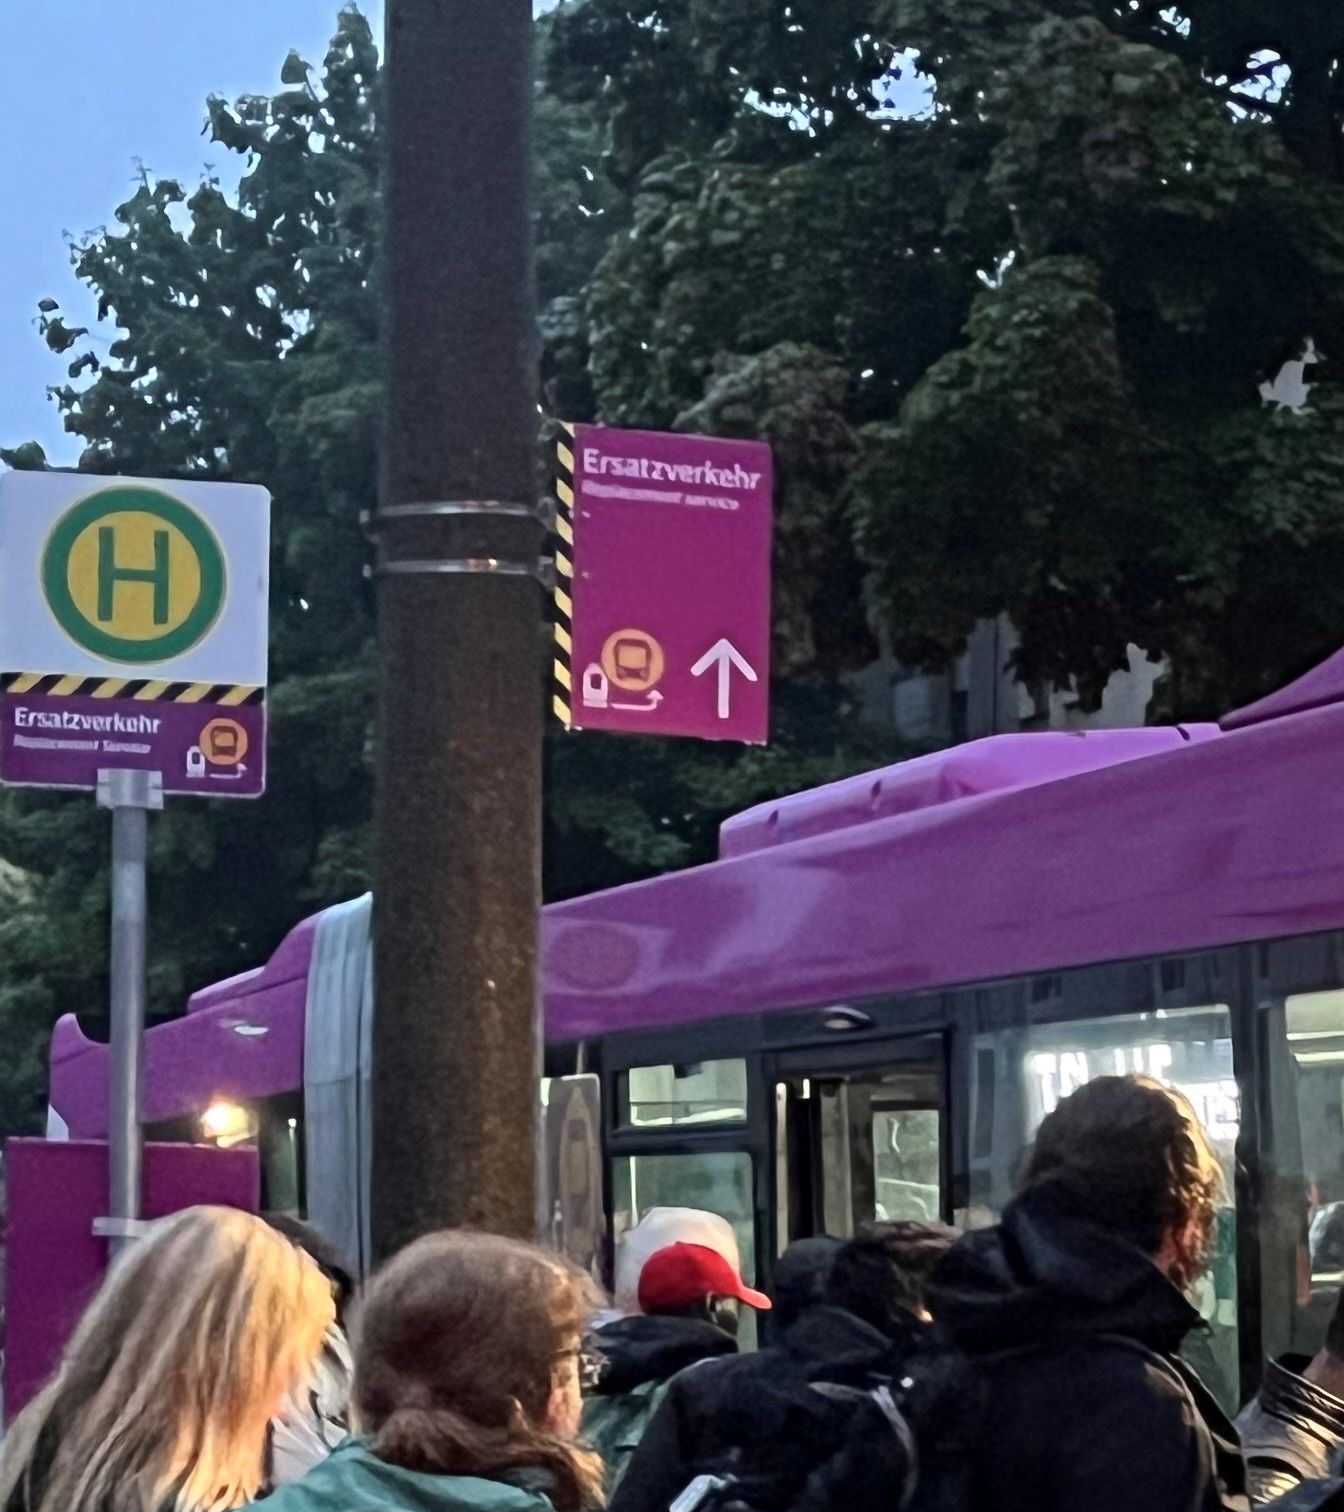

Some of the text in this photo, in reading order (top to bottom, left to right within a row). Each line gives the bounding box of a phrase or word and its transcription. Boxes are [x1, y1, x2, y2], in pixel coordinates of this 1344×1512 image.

[583, 447, 761, 490] Ersatzverkehr
[97, 526, 169, 625] H
[14, 706, 161, 733] Ersatzverkehr
